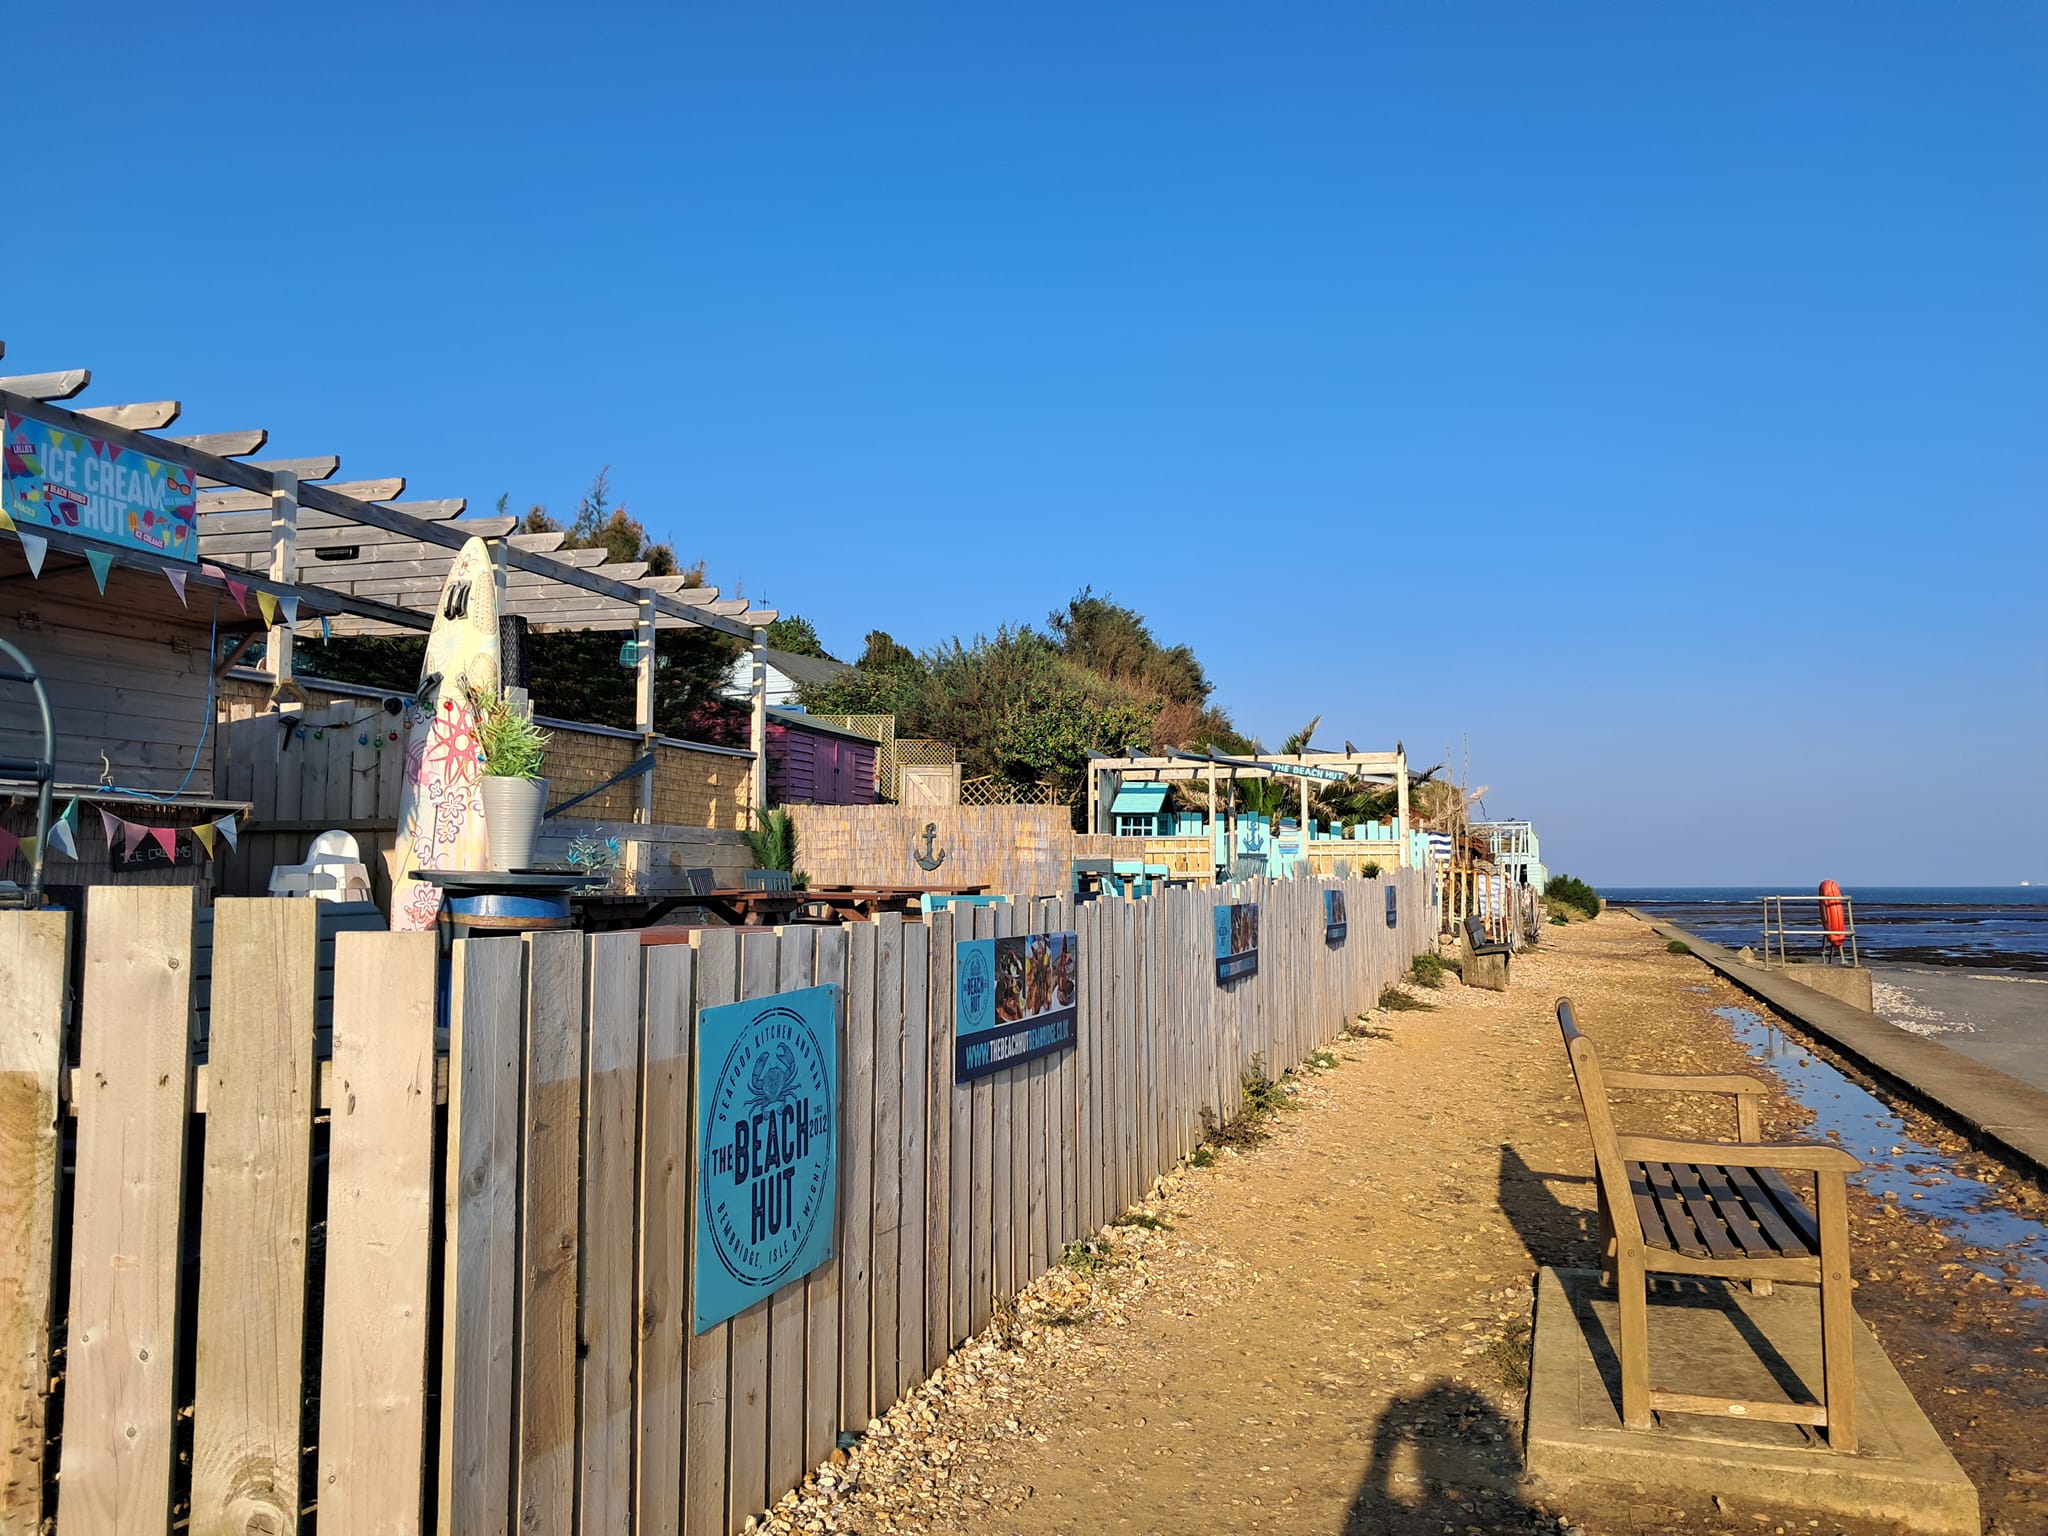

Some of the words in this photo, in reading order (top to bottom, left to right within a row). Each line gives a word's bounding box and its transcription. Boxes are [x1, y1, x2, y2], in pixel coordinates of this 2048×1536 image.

[40, 443, 77, 488] ICE
[84, 456, 165, 511] CREAM
[84, 493, 128, 537] HUT
[1271, 763, 1290, 773] THE
[1292, 766, 1324, 779] BEACH
[1325, 770, 1345, 780] HUT
[967, 976, 984, 996] BEACH
[718, 1048, 751, 1122] SEAFOOD
[754, 1023, 792, 1050] KITCHEN
[794, 1031, 811, 1061] AND
[809, 1060, 822, 1092] BAR
[711, 1142, 734, 1176] THE
[734, 1098, 809, 1186] BEACH
[809, 1114, 828, 1139] 2012
[716, 1200, 764, 1269] BEMBRIDGE,
[768, 1243, 789, 1264] ISLE
[792, 1222, 803, 1243] OF
[803, 1162, 822, 1217] WIGHT
[750, 1167, 796, 1245] HUT
